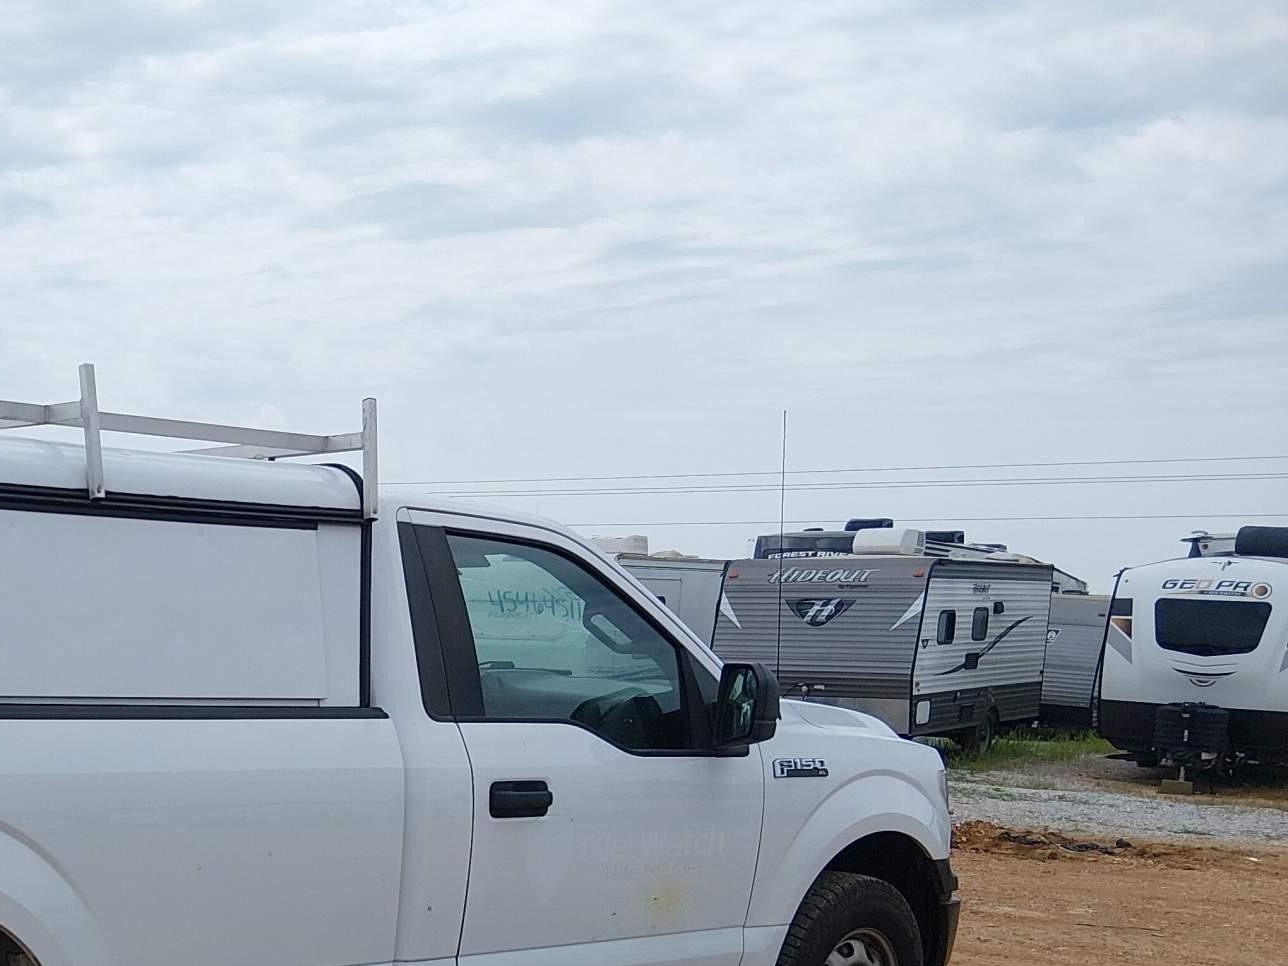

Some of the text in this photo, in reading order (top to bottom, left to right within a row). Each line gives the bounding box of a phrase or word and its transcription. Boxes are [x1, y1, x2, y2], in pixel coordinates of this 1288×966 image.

[768, 551, 853, 560] FOREST RIV
[767, 566, 880, 584] HIDEOUT
